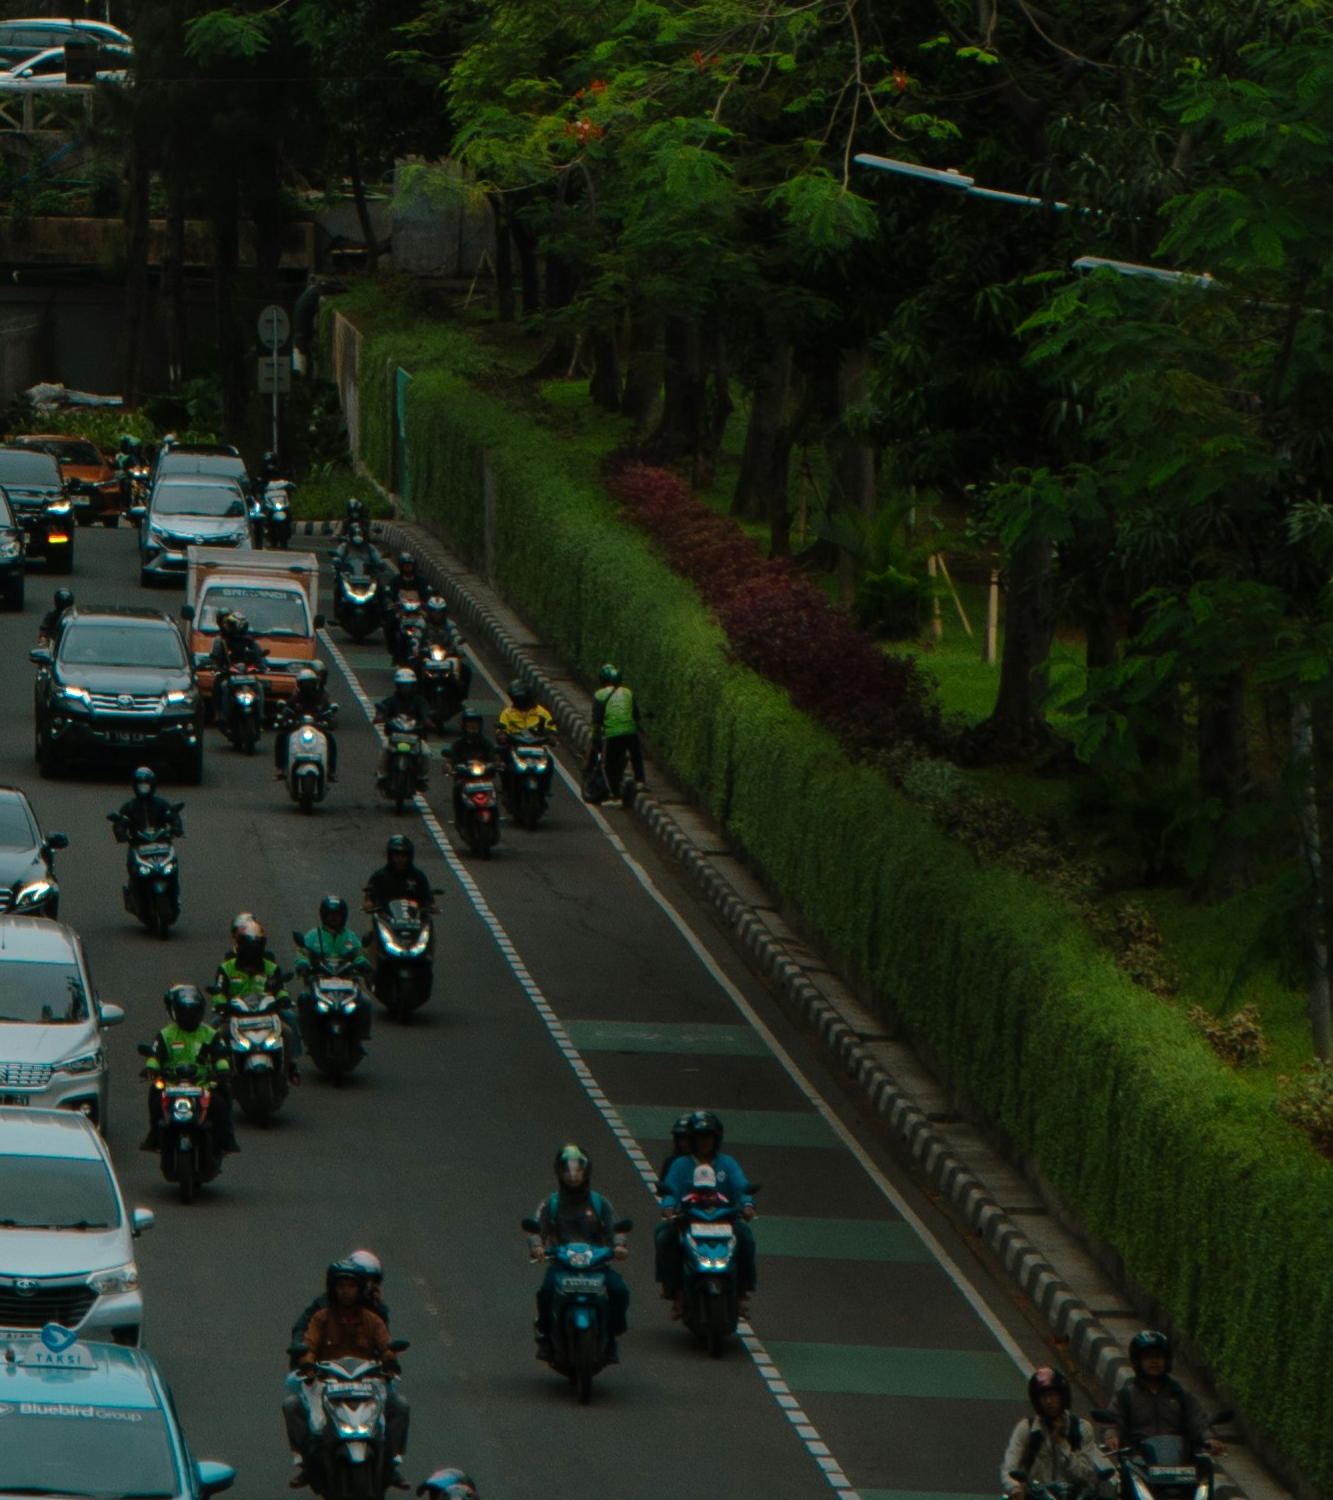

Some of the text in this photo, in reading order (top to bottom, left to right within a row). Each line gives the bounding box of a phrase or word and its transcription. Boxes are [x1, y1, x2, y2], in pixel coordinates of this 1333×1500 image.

[36, 1353, 81, 1365] TAKSI
[19, 1402, 143, 1423] Bluebird Group
